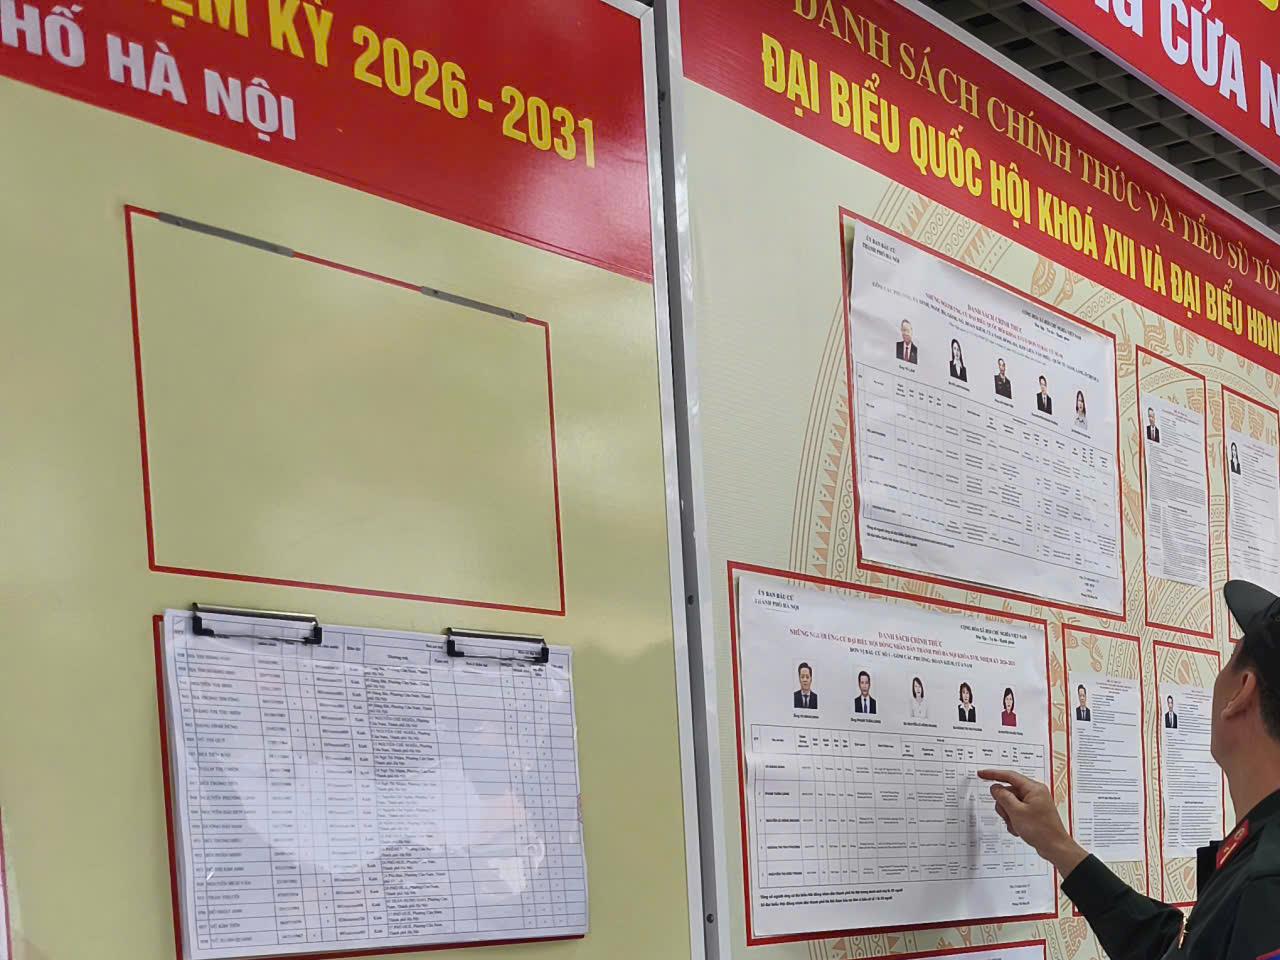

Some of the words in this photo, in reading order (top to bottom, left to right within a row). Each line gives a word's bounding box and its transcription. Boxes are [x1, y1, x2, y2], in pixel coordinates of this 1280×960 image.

[107, 33, 187, 104] HÀ
[204, 68, 296, 141] NỘI
[353, 24, 469, 119] 2026
[501, 86, 596, 168] 2031
[1160, 0, 1248, 112] CỬA
[761, 32, 821, 117] ĐẠI
[829, 72, 900, 154] BIỂU
[909, 116, 982, 197] QUỐC
[990, 159, 1031, 229] HỘI
[1037, 187, 1098, 260] KHOÁ
[1103, 224, 1136, 281] XVI
[1140, 243, 1167, 297] VÀ
[1170, 261, 1202, 318] ĐẠI
[1206, 280, 1243, 335] BIỂU
[899, 43, 980, 119] SÁCH
[987, 97, 1072, 174] CHÍNH
[1077, 149, 1142, 213] THỨC
[1145, 193, 1175, 234] VÀ
[1178, 211, 1224, 260] TIỂU
[1227, 240, 1249, 276] SỬ
